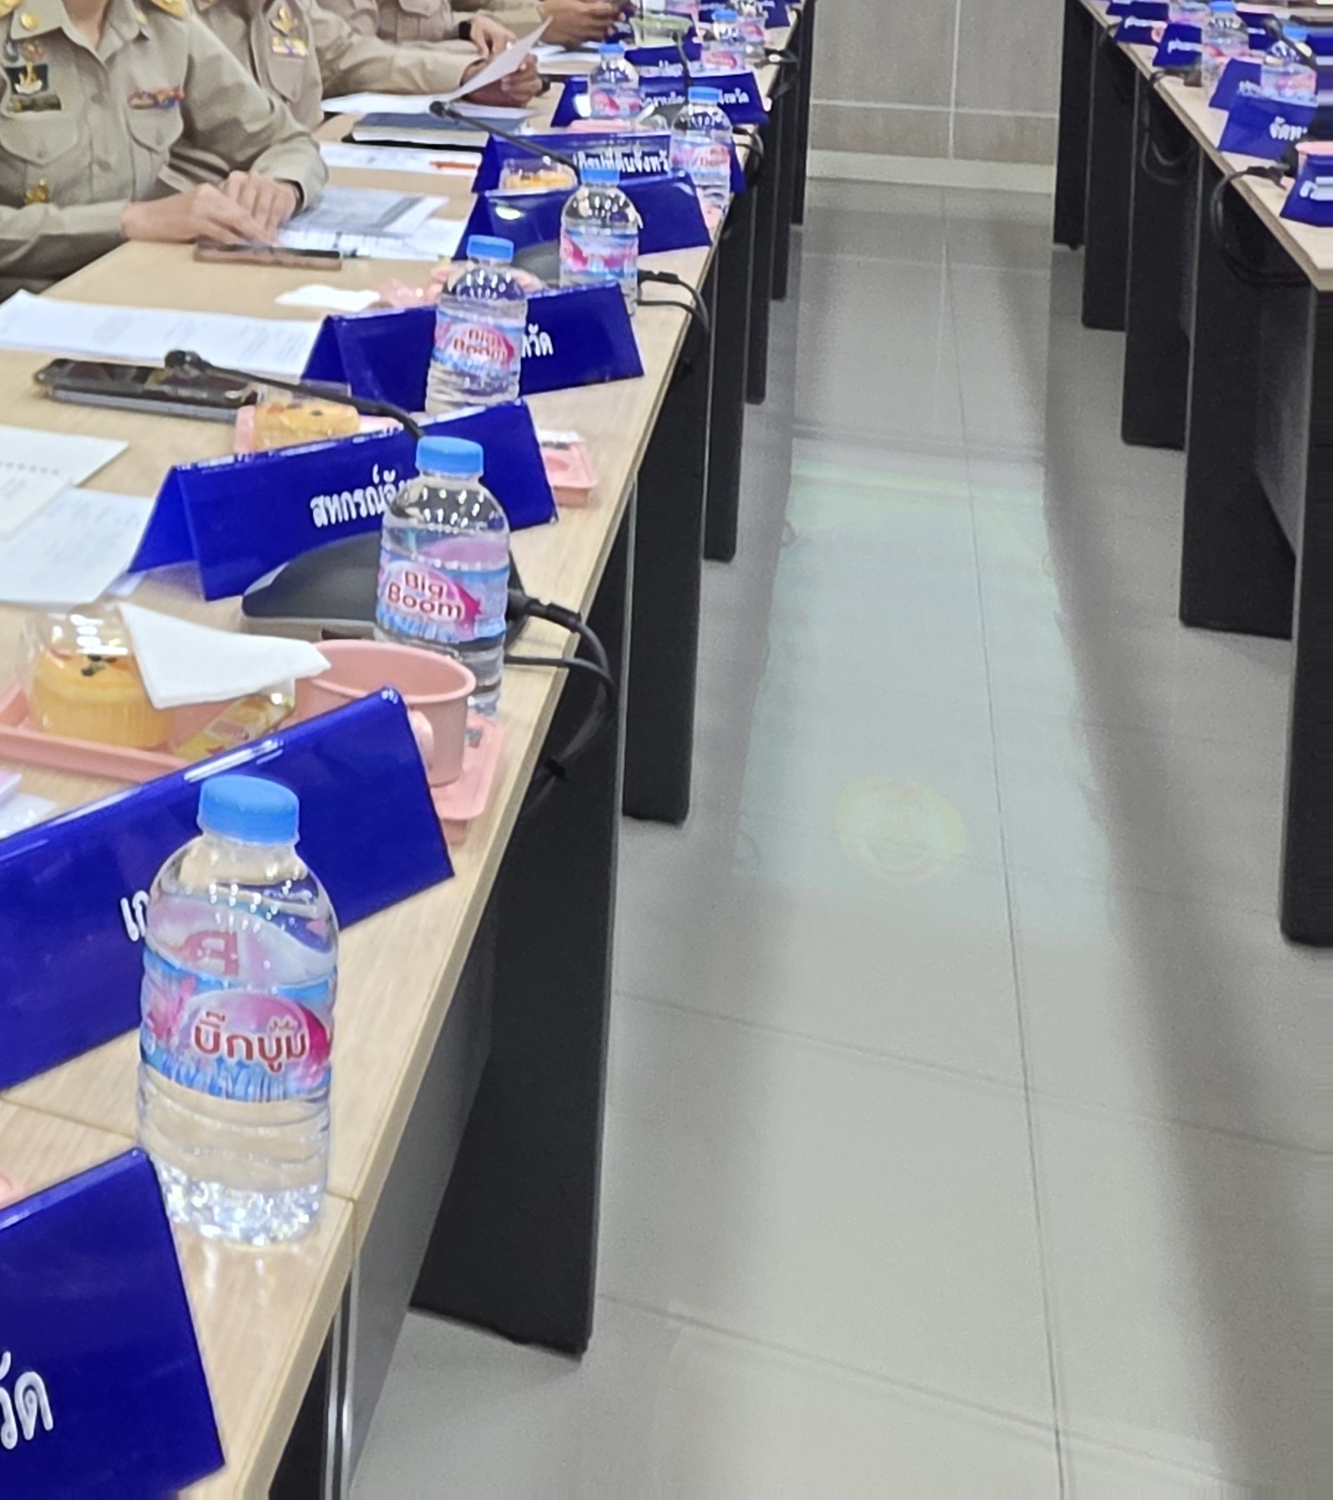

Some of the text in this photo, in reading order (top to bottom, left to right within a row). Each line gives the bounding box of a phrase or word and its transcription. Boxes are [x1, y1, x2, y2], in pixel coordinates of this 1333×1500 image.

[388, 581, 463, 621] Boom
[404, 570, 445, 600] Big
[193, 1010, 307, 1074] บิ๊กบูม
